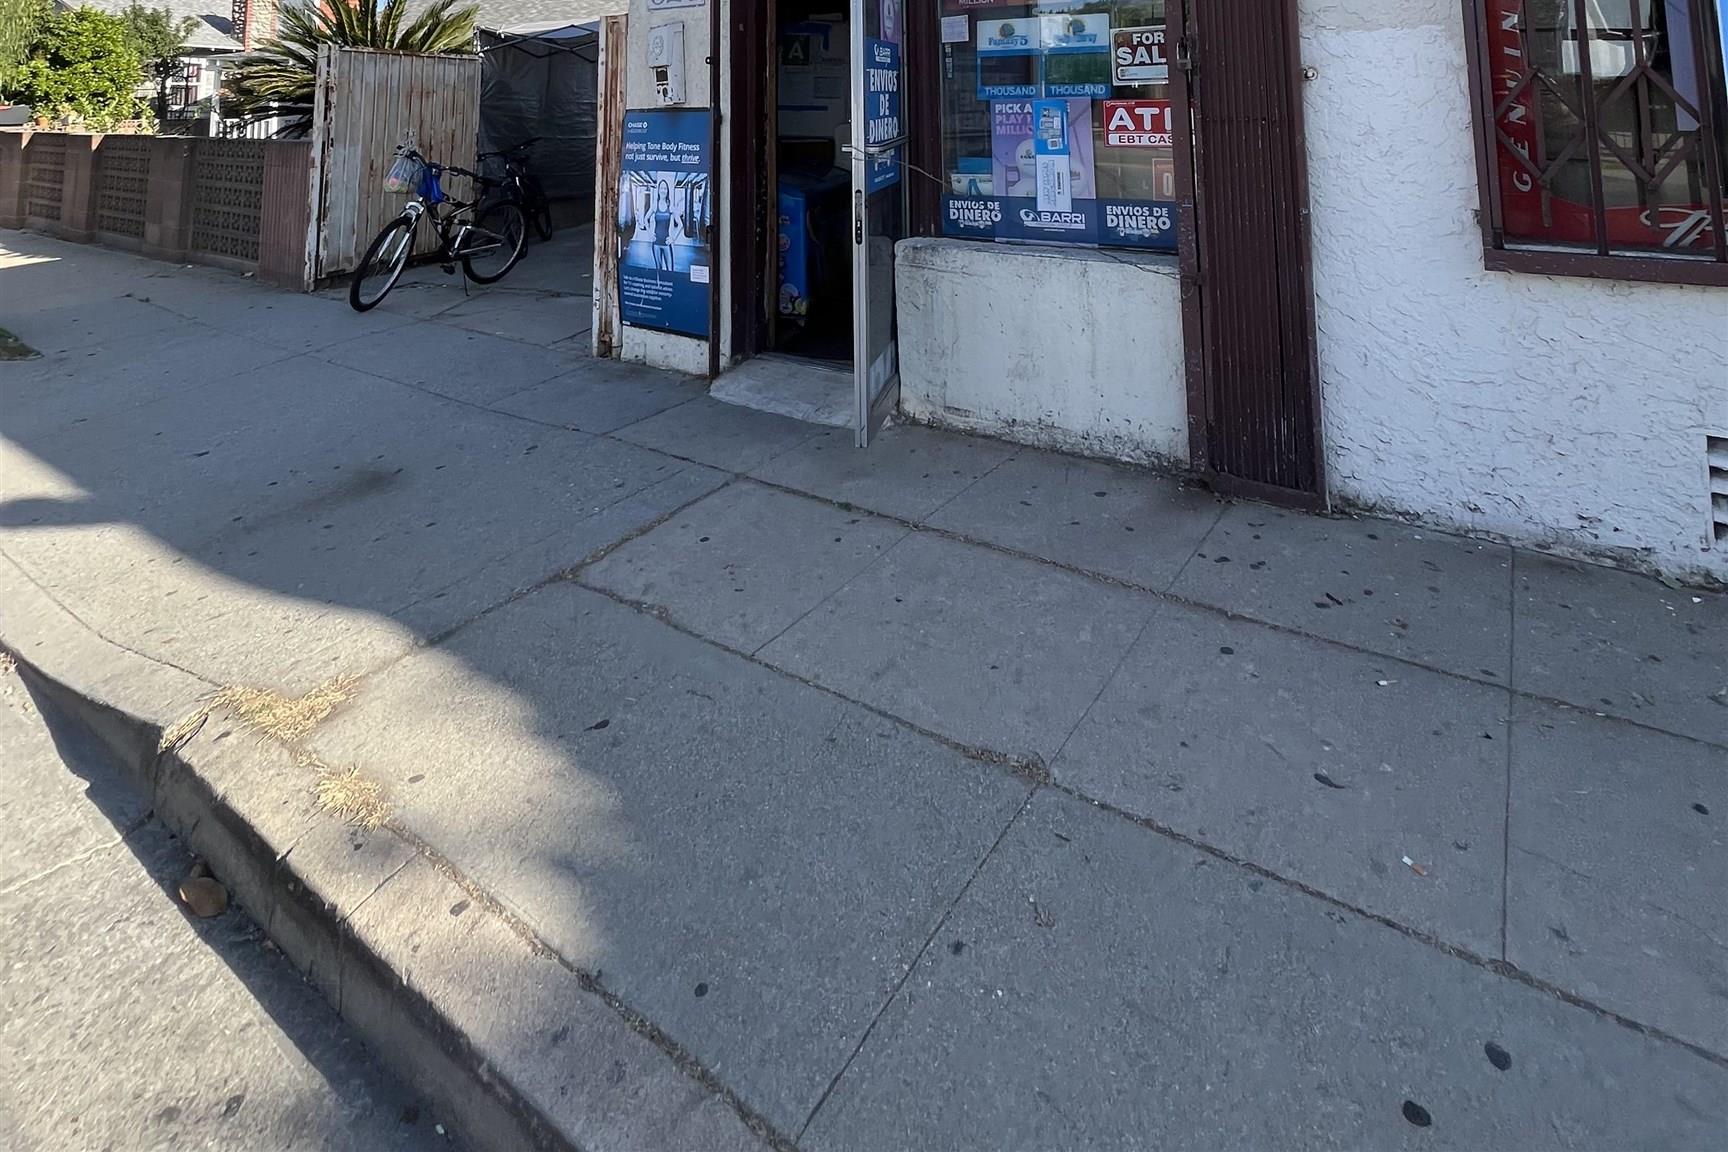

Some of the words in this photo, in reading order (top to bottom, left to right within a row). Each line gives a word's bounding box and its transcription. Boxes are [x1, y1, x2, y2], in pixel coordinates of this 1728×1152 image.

[1020, 34, 1028, 45] 5
[1132, 32, 1165, 45] FOR
[1117, 45, 1166, 65] SAL
[985, 86, 1036, 96] THOUSAND
[1050, 84, 1105, 95] THOUSAND
[880, 93, 889, 116] DE
[995, 103, 1021, 113] PICK
[1024, 103, 1032, 113] A
[995, 115, 1023, 124] PLAY
[869, 117, 898, 143] DINERO
[1119, 135, 1144, 144] EBT
[1148, 135, 1173, 144] CAS
[626, 142, 646, 152] Helping
[647, 142, 660, 150] Tone
[662, 143, 677, 152] Body
[679, 143, 700, 151] Fitness
[635, 153, 645, 162] just
[987, 201, 1000, 210] DE
[950, 209, 1001, 222] DINERO
[1041, 212, 1085, 223] BARRI
[1153, 207, 1168, 217] DE
[1107, 215, 1170, 229] DINERO
